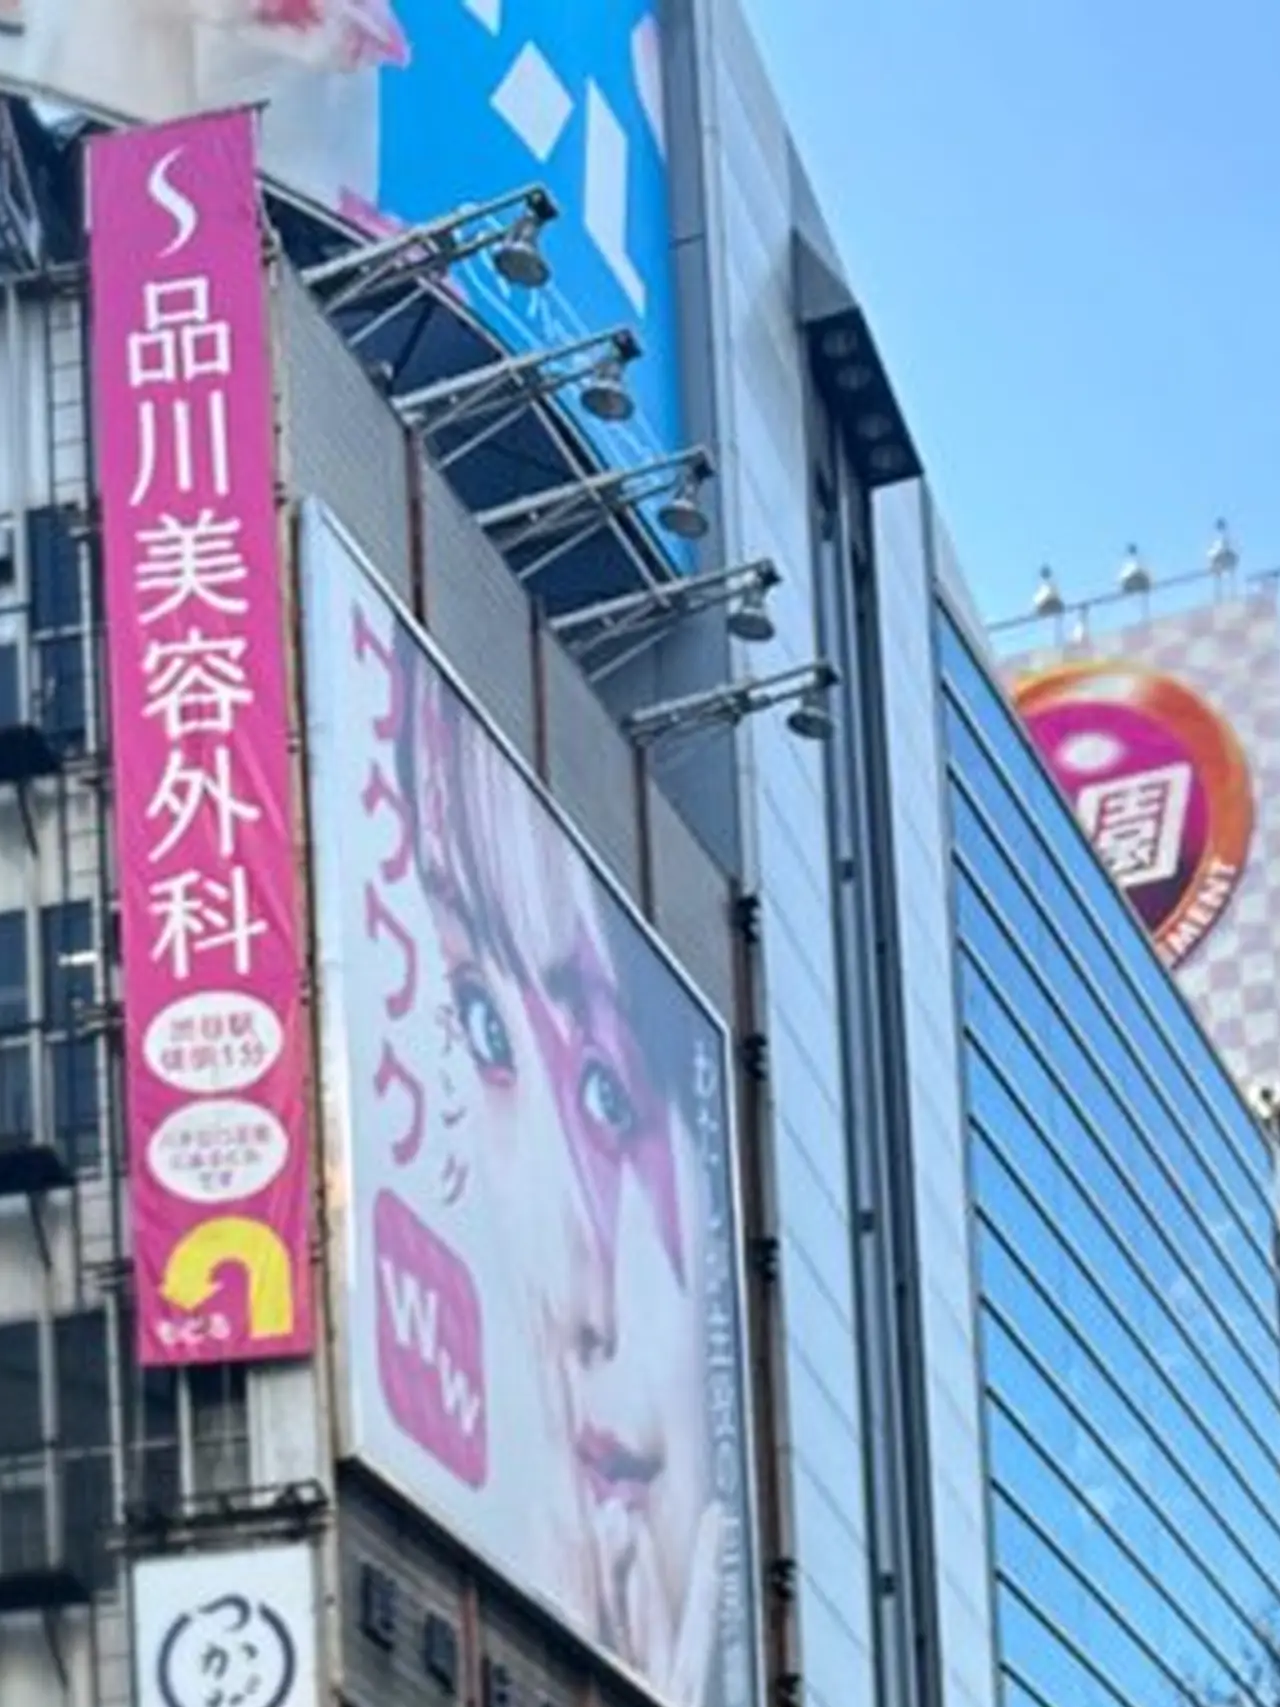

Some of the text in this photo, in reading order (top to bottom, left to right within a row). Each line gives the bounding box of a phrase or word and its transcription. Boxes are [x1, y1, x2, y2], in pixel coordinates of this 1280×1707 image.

[125, 277, 268, 981] 品川美容外科
